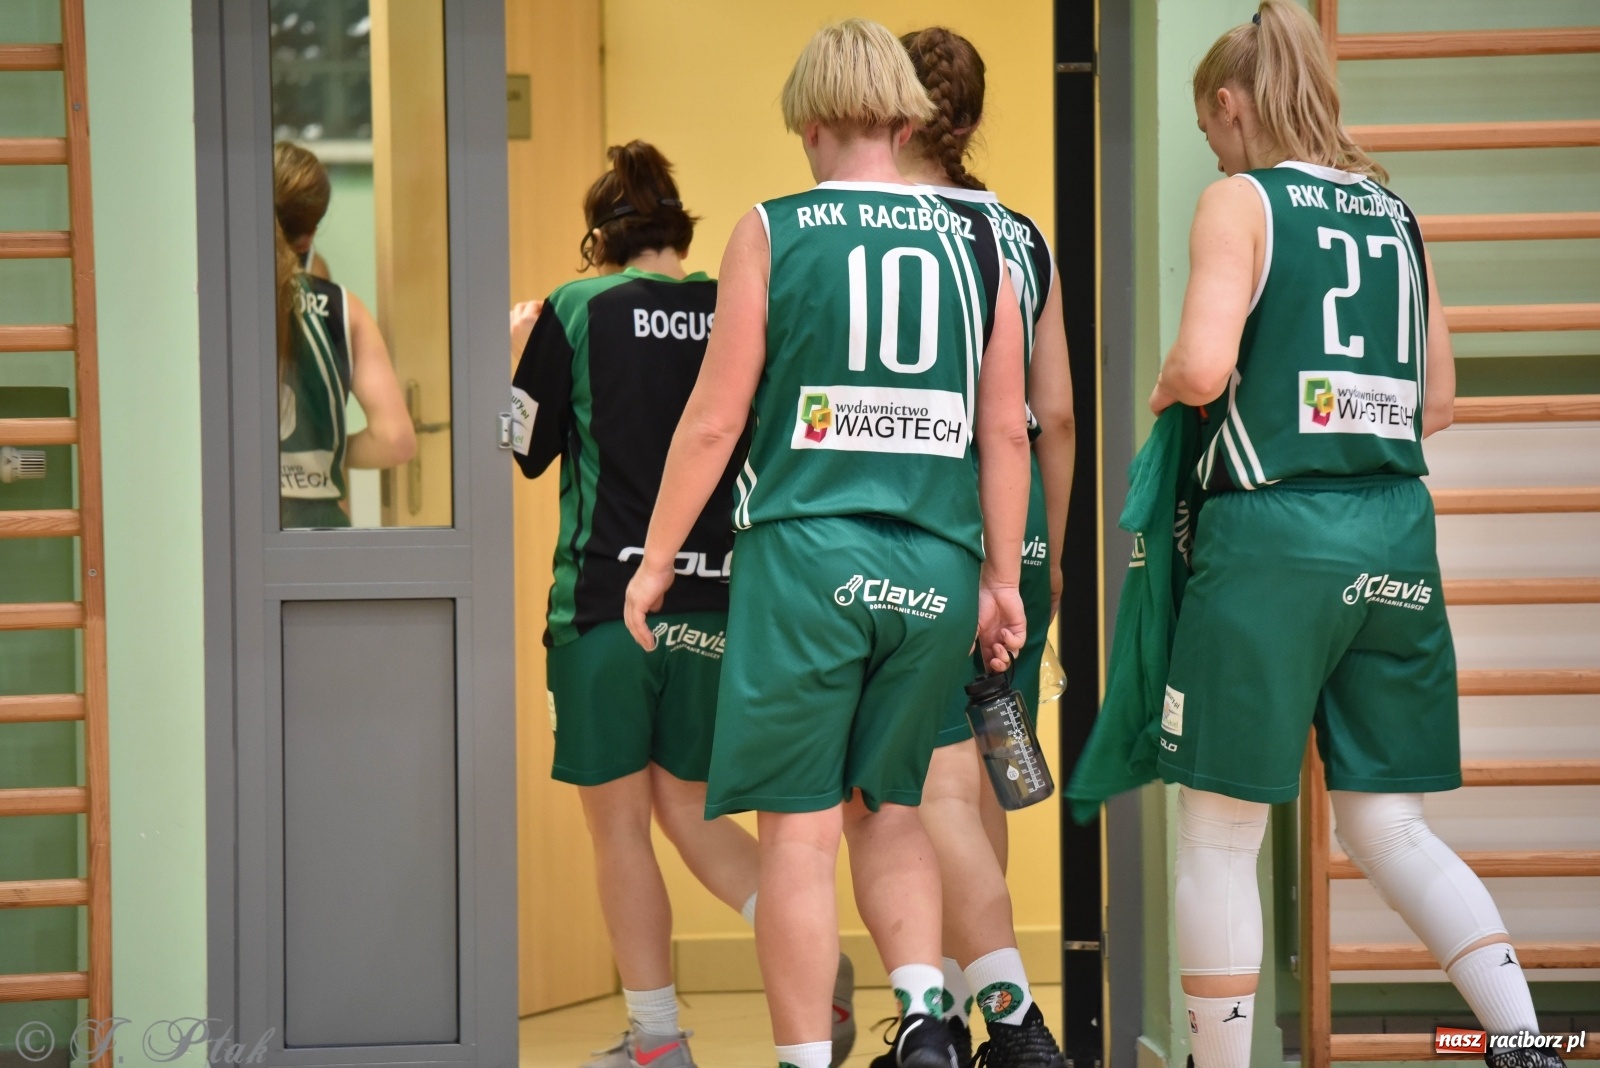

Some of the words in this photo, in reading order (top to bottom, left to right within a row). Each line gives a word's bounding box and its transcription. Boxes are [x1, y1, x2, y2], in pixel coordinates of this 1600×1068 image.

[1286, 184, 1329, 210] RKK
[797, 203, 847, 229] RKK
[858, 202, 976, 241] RACIBÓRZ
[848, 244, 940, 374] 10
[1317, 226, 1410, 364] 27
[1337, 385, 1397, 403] wydawnictwo
[835, 401, 929, 418] wydawnictwo
[1337, 398, 1414, 429] WAGTECH
[834, 414, 962, 443] WAGTECH
[863, 579, 948, 613] Clavis
[1364, 574, 1432, 604] Clavis
[912, 609, 938, 620] KLUCZY
